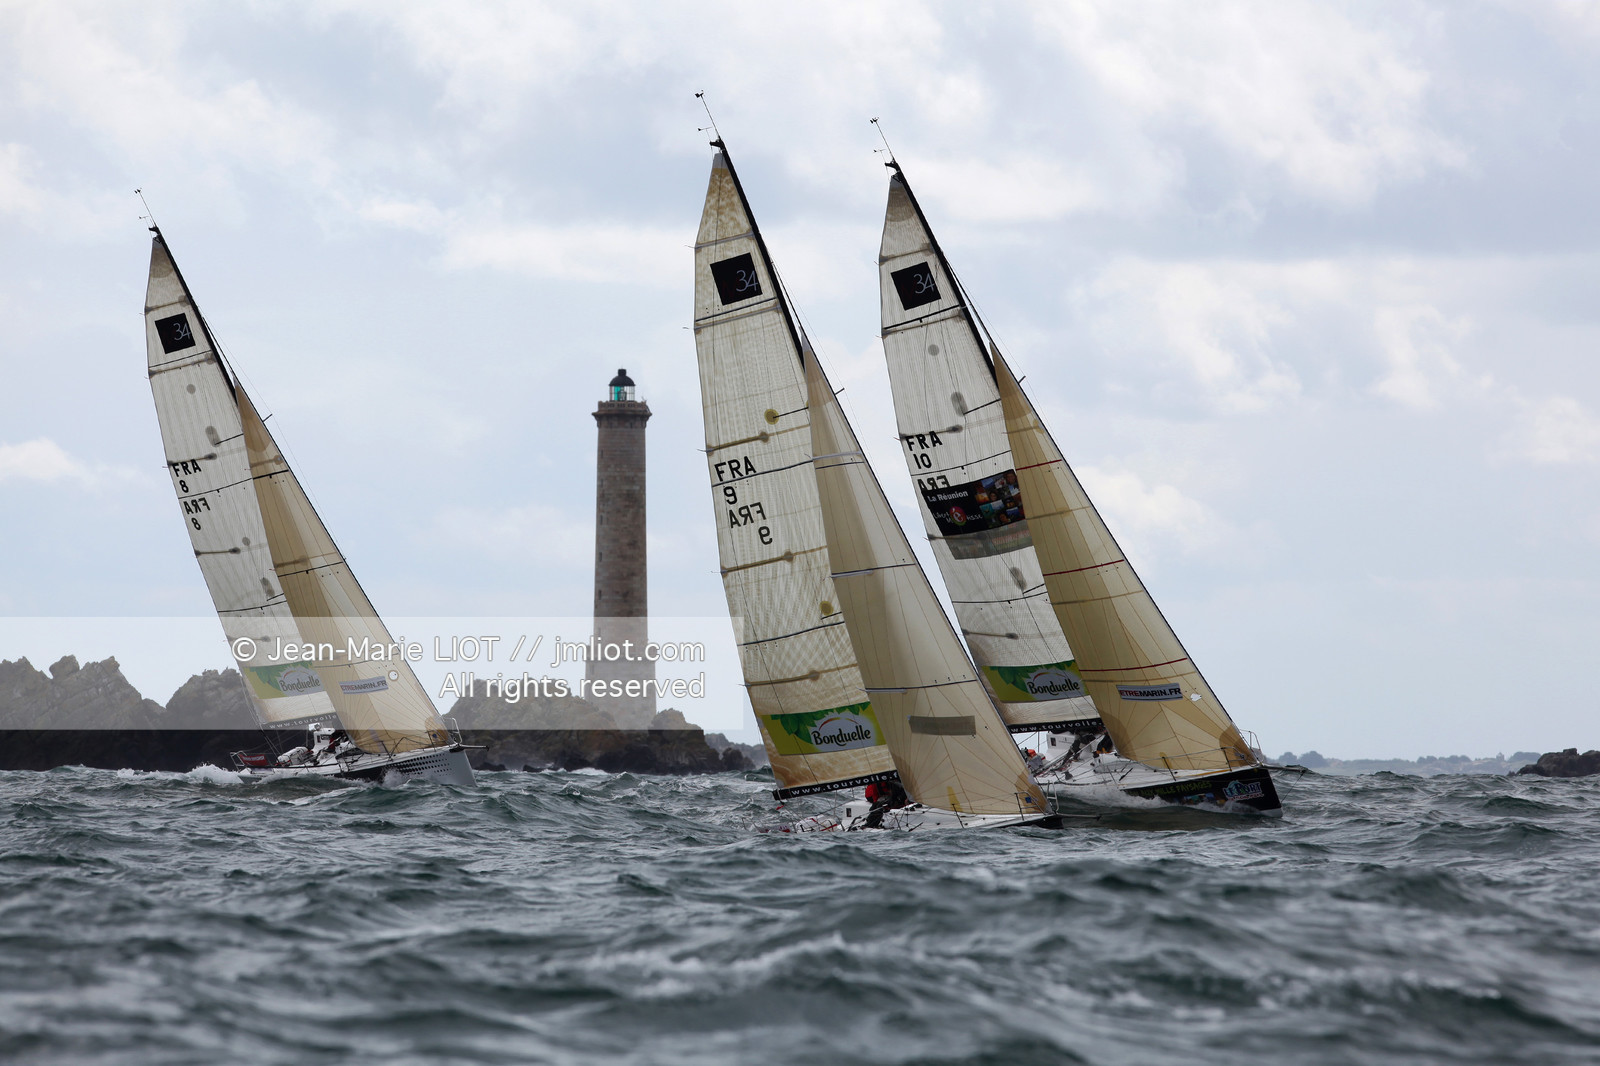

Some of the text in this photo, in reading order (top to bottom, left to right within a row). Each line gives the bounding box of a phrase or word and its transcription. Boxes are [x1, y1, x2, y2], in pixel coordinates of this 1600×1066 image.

[905, 431, 943, 452] FRA
[172, 459, 202, 477] FRA
[713, 455, 757, 482] FRA
[913, 453, 933, 470] 10
[179, 479, 189, 493] 8
[723, 486, 738, 505] 9
[278, 675, 321, 694] Bonduelle
[1027, 678, 1081, 698] Bonduelle
[811, 724, 872, 747] Bonduelle
